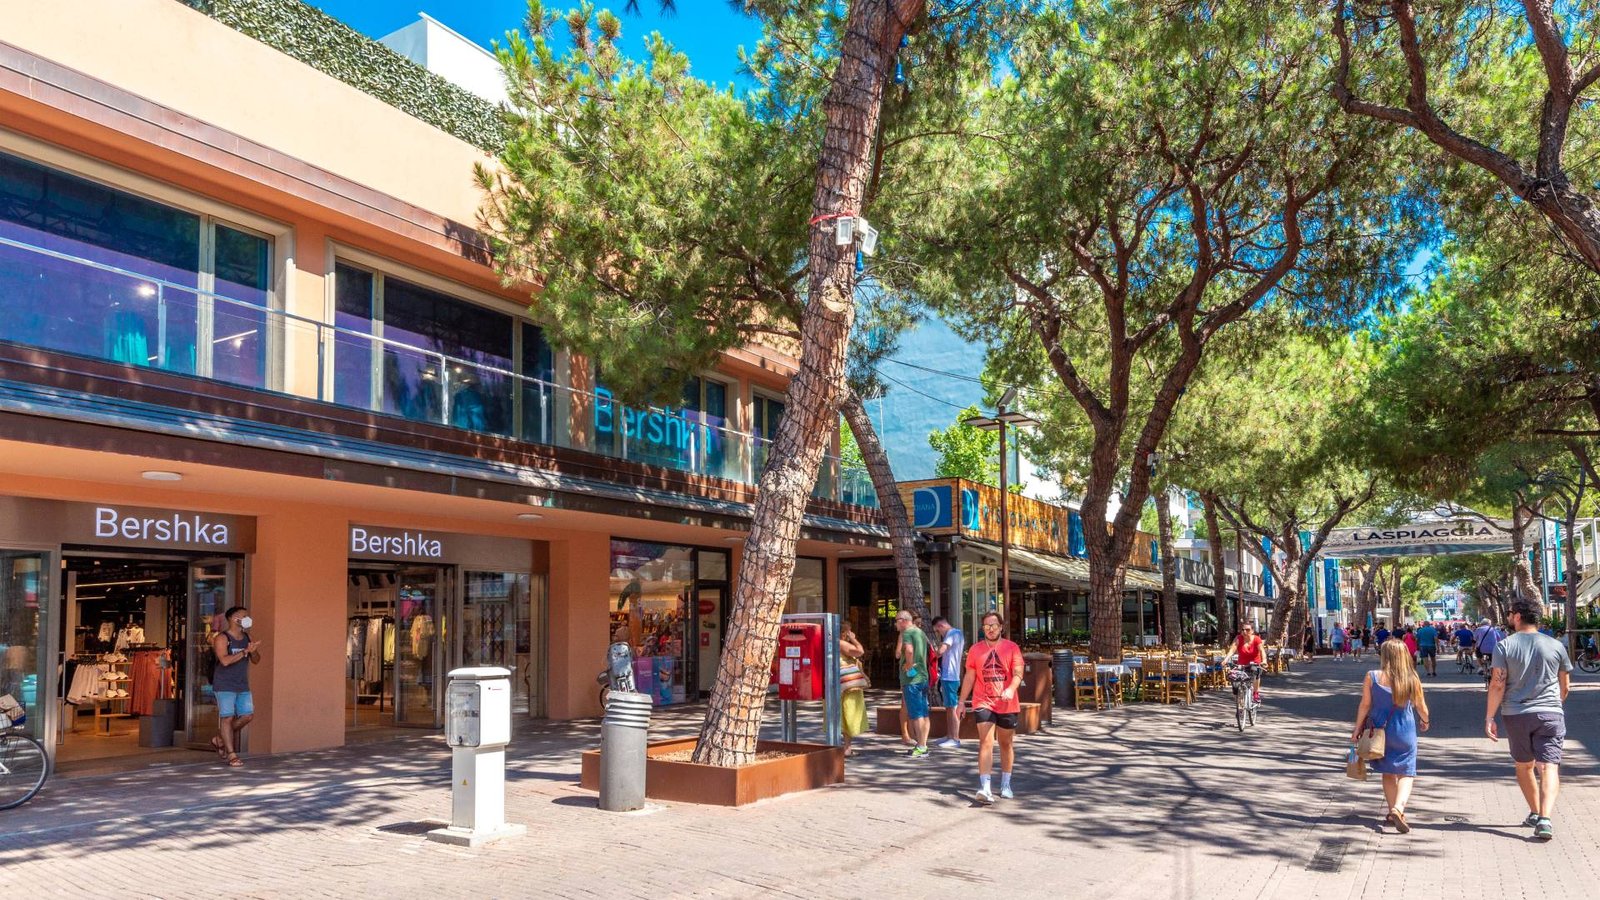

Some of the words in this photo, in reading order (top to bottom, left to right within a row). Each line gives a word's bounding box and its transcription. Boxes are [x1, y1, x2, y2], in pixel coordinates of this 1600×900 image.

[594, 386, 712, 454] Bershka
[95, 507, 228, 545] Bershka
[352, 528, 442, 557] Bershka
[1353, 526, 1494, 541] LASPIAGGIA
